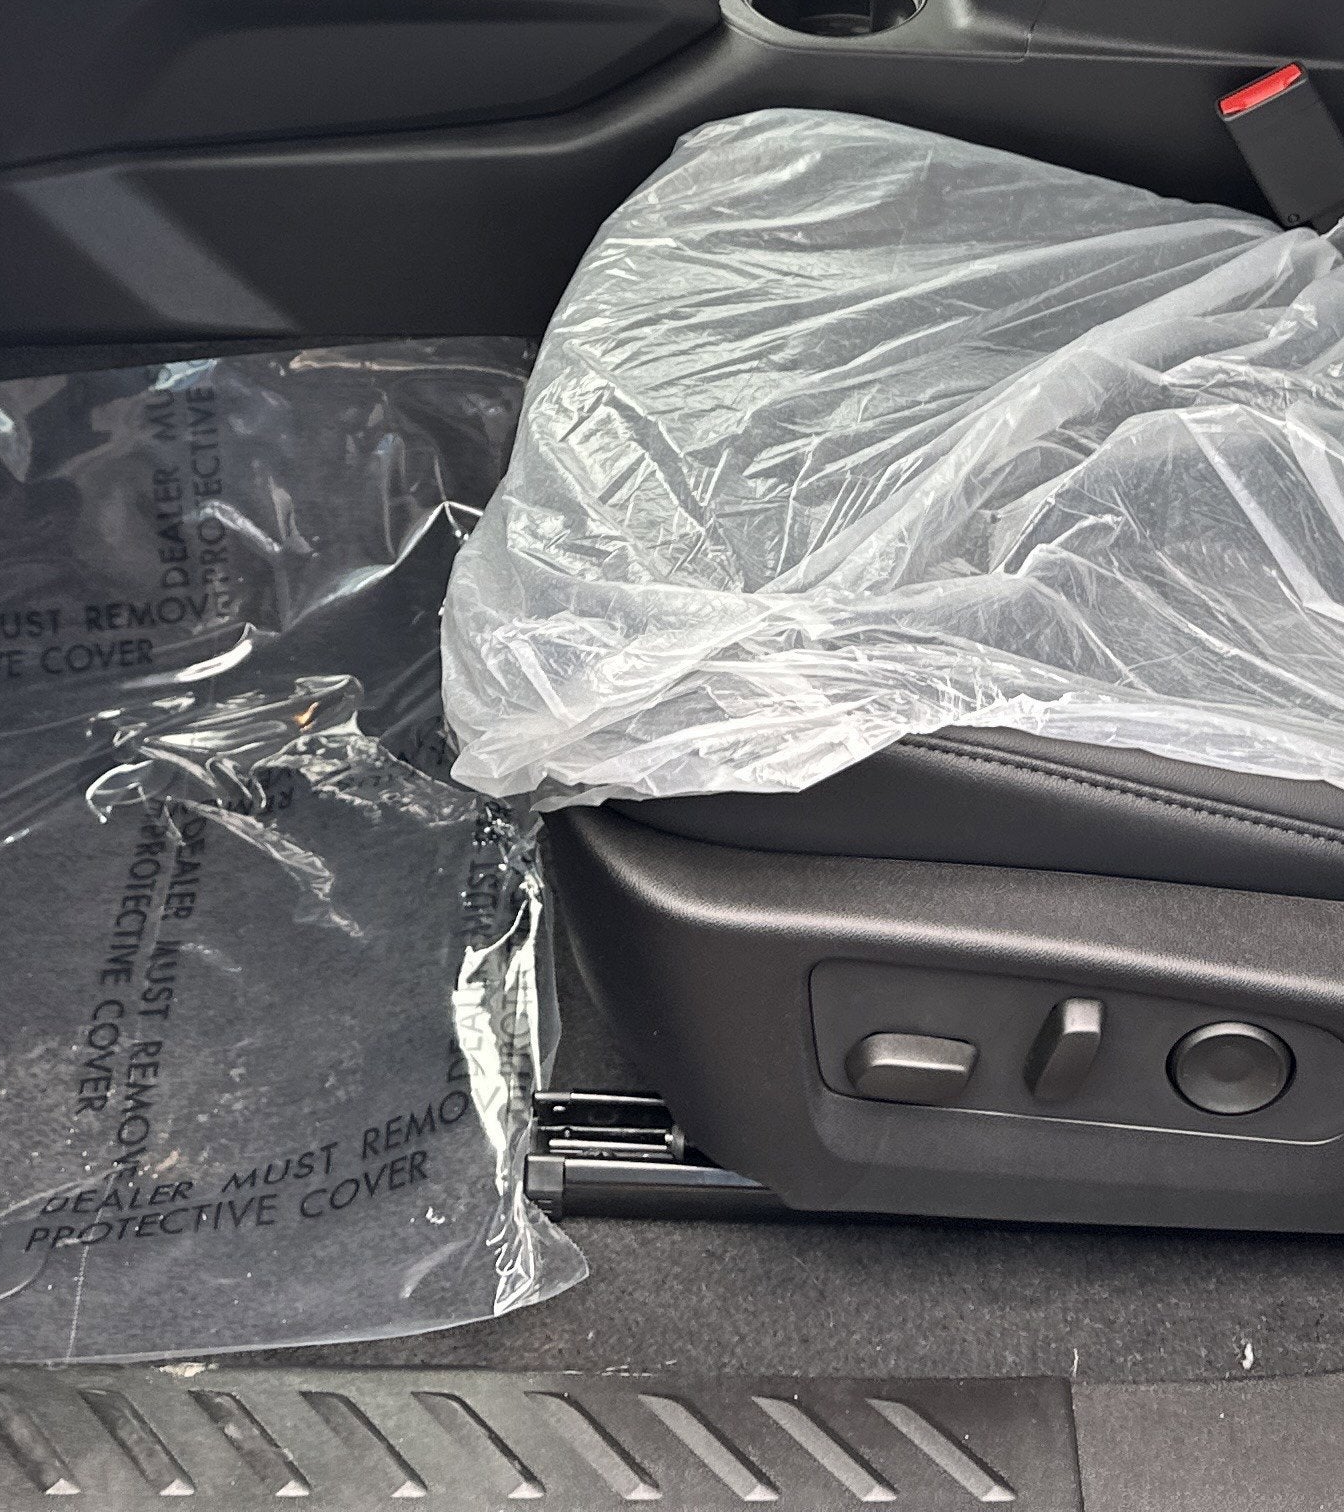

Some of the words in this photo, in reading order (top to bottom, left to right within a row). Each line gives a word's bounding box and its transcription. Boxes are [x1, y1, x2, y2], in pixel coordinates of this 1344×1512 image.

[153, 464, 190, 590] DEALER
[184, 386, 233, 586] PROTECTIVE
[39, 638, 154, 674] COVER
[99, 823, 163, 986] PROTECTIVE
[159, 815, 208, 923] DEALER
[137, 938, 183, 1022] MUST
[74, 998, 126, 1115] COVER
[106, 1039, 164, 1184] REMOVE
[24, 1193, 278, 1253] PROTECTIVE
[299, 1149, 429, 1220] COVER
[41, 1179, 194, 1217] DEALER
[221, 1140, 339, 1193] MUST
